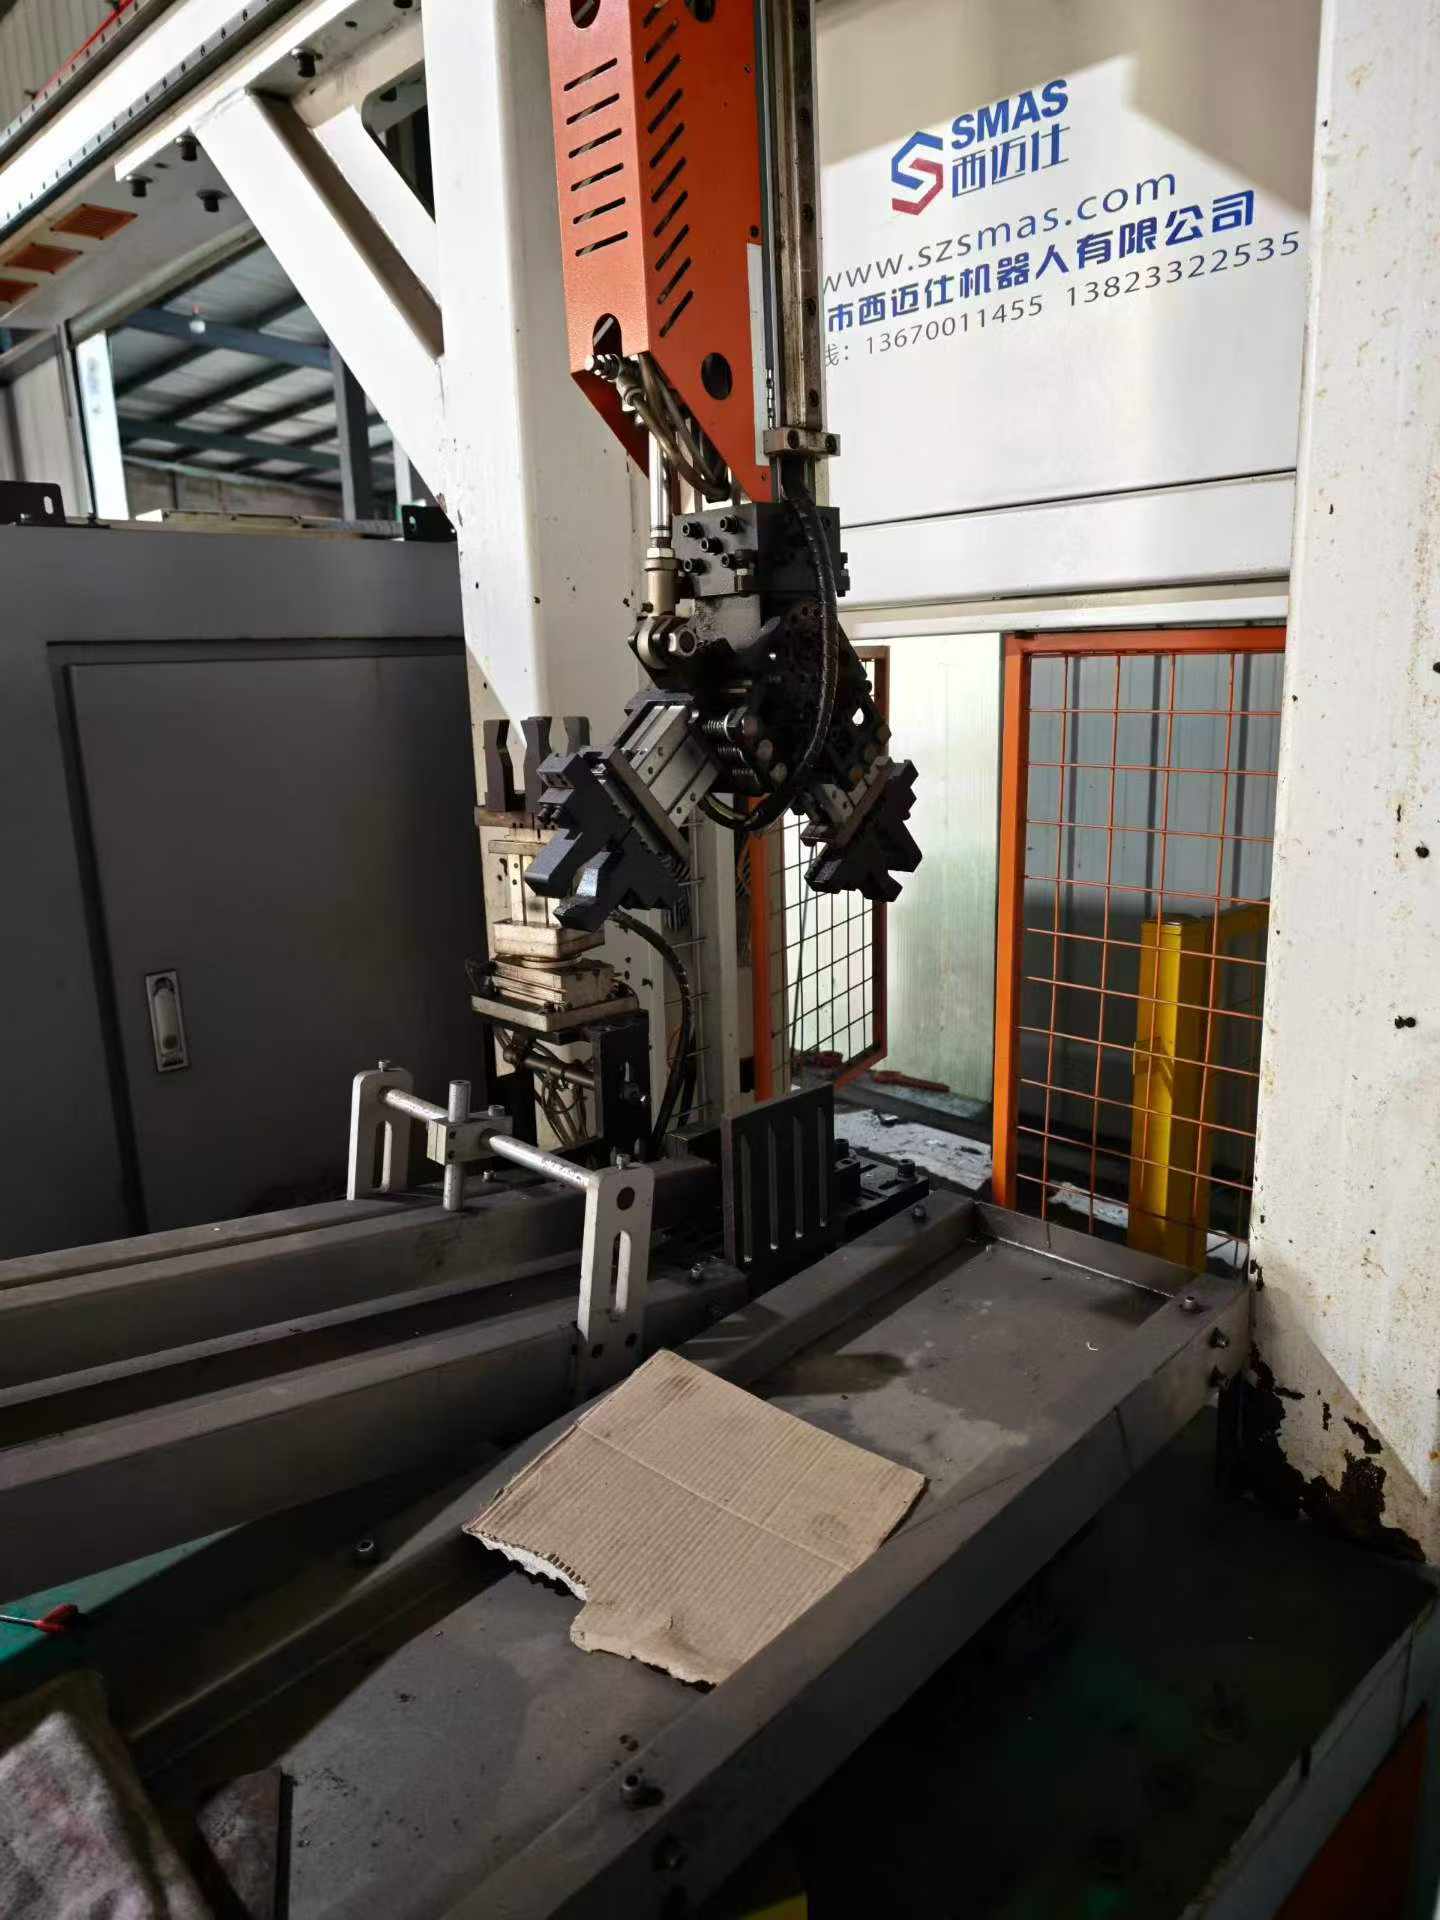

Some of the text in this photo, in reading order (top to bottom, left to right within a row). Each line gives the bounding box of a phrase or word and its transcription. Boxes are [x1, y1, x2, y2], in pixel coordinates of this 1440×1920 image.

[950, 79, 1069, 151] SMAS
[951, 123, 1071, 199] 西迈仕
[823, 173, 1176, 295] www.szsmas.com
[827, 189, 1255, 333] 市西迈仕机器人有限公司
[866, 294, 1043, 355] 13670011455
[1066, 230, 1300, 307] 13823322535
